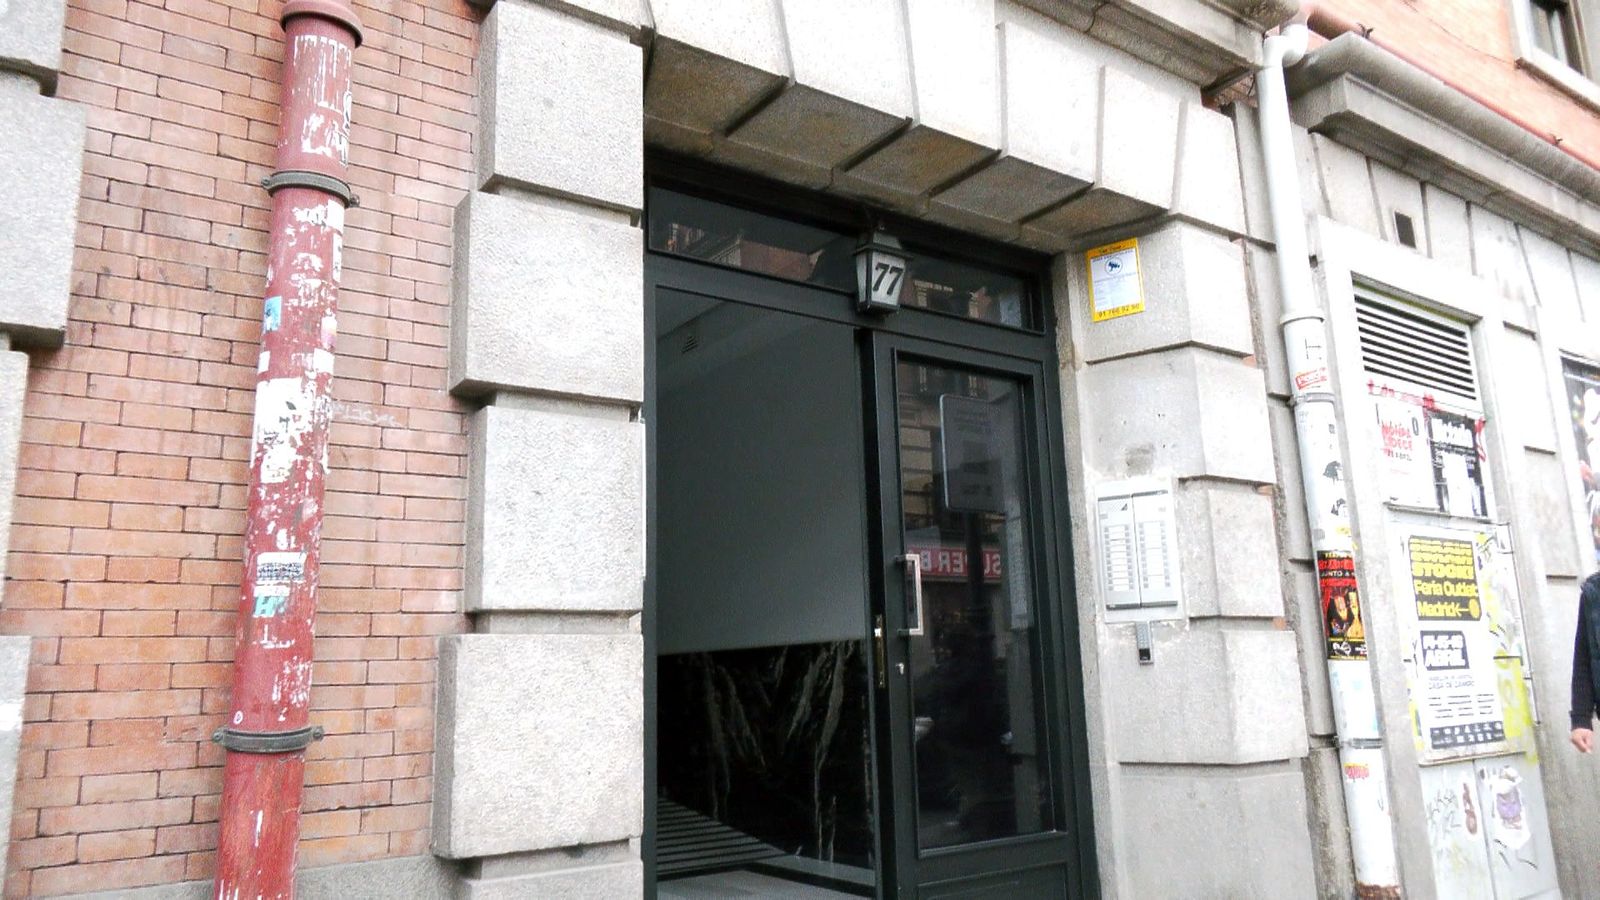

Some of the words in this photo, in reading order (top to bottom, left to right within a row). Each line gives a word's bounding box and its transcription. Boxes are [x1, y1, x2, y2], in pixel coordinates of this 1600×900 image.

[872, 262, 904, 296] 77
[1414, 579, 1442, 595] Feria
[1417, 601, 1456, 616] Madrid
